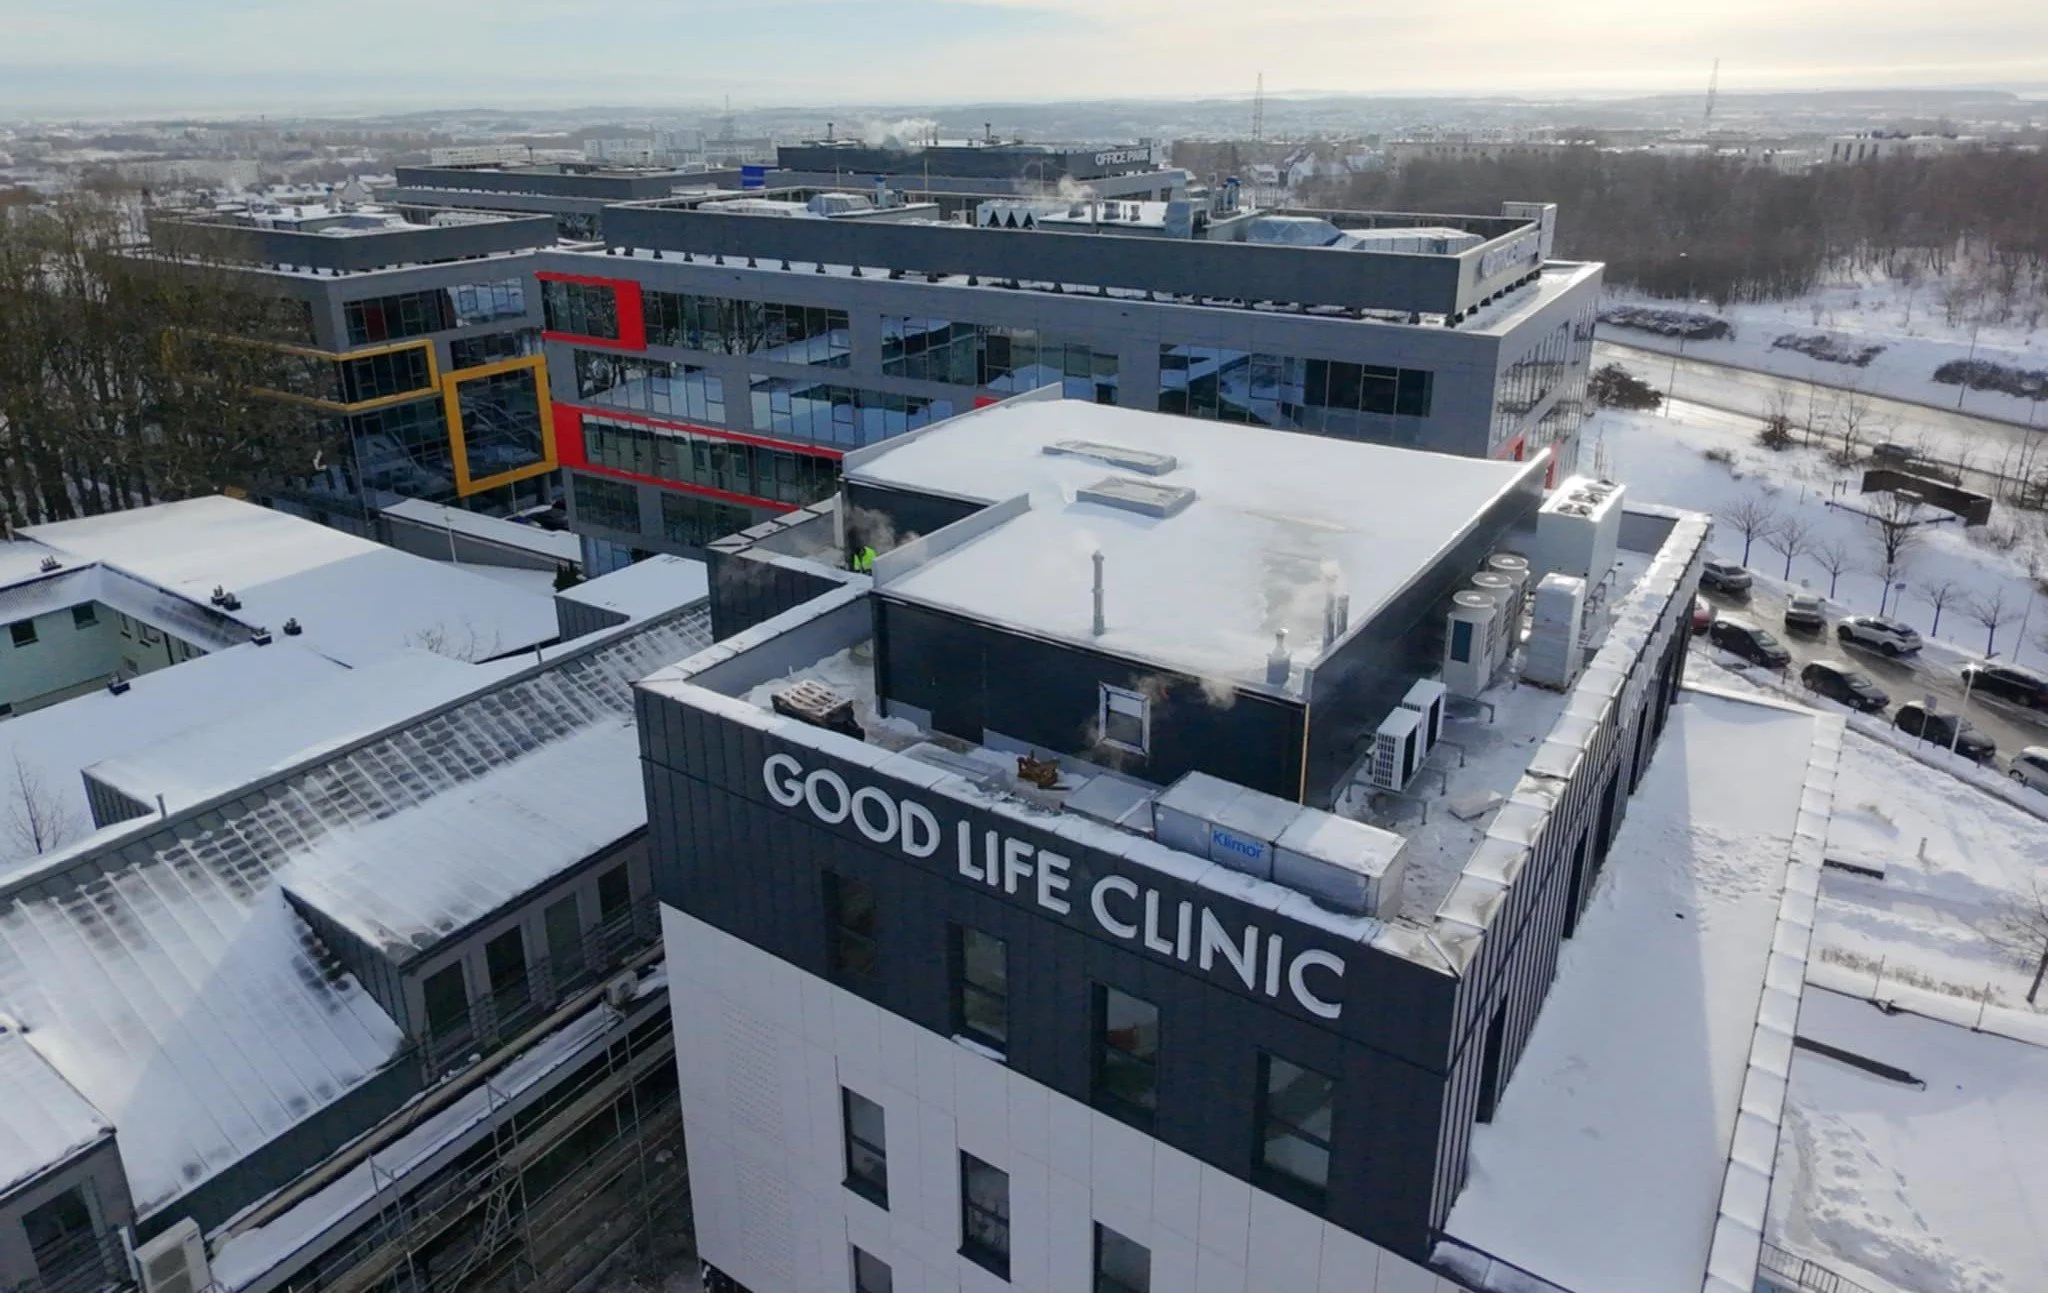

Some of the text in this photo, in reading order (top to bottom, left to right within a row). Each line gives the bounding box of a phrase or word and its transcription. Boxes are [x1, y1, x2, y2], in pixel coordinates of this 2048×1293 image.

[1095, 151, 1127, 166] OFFICE
[1212, 829, 1264, 858] Klimor
[762, 753, 1345, 1019] GOOD LIFE CLINIC
